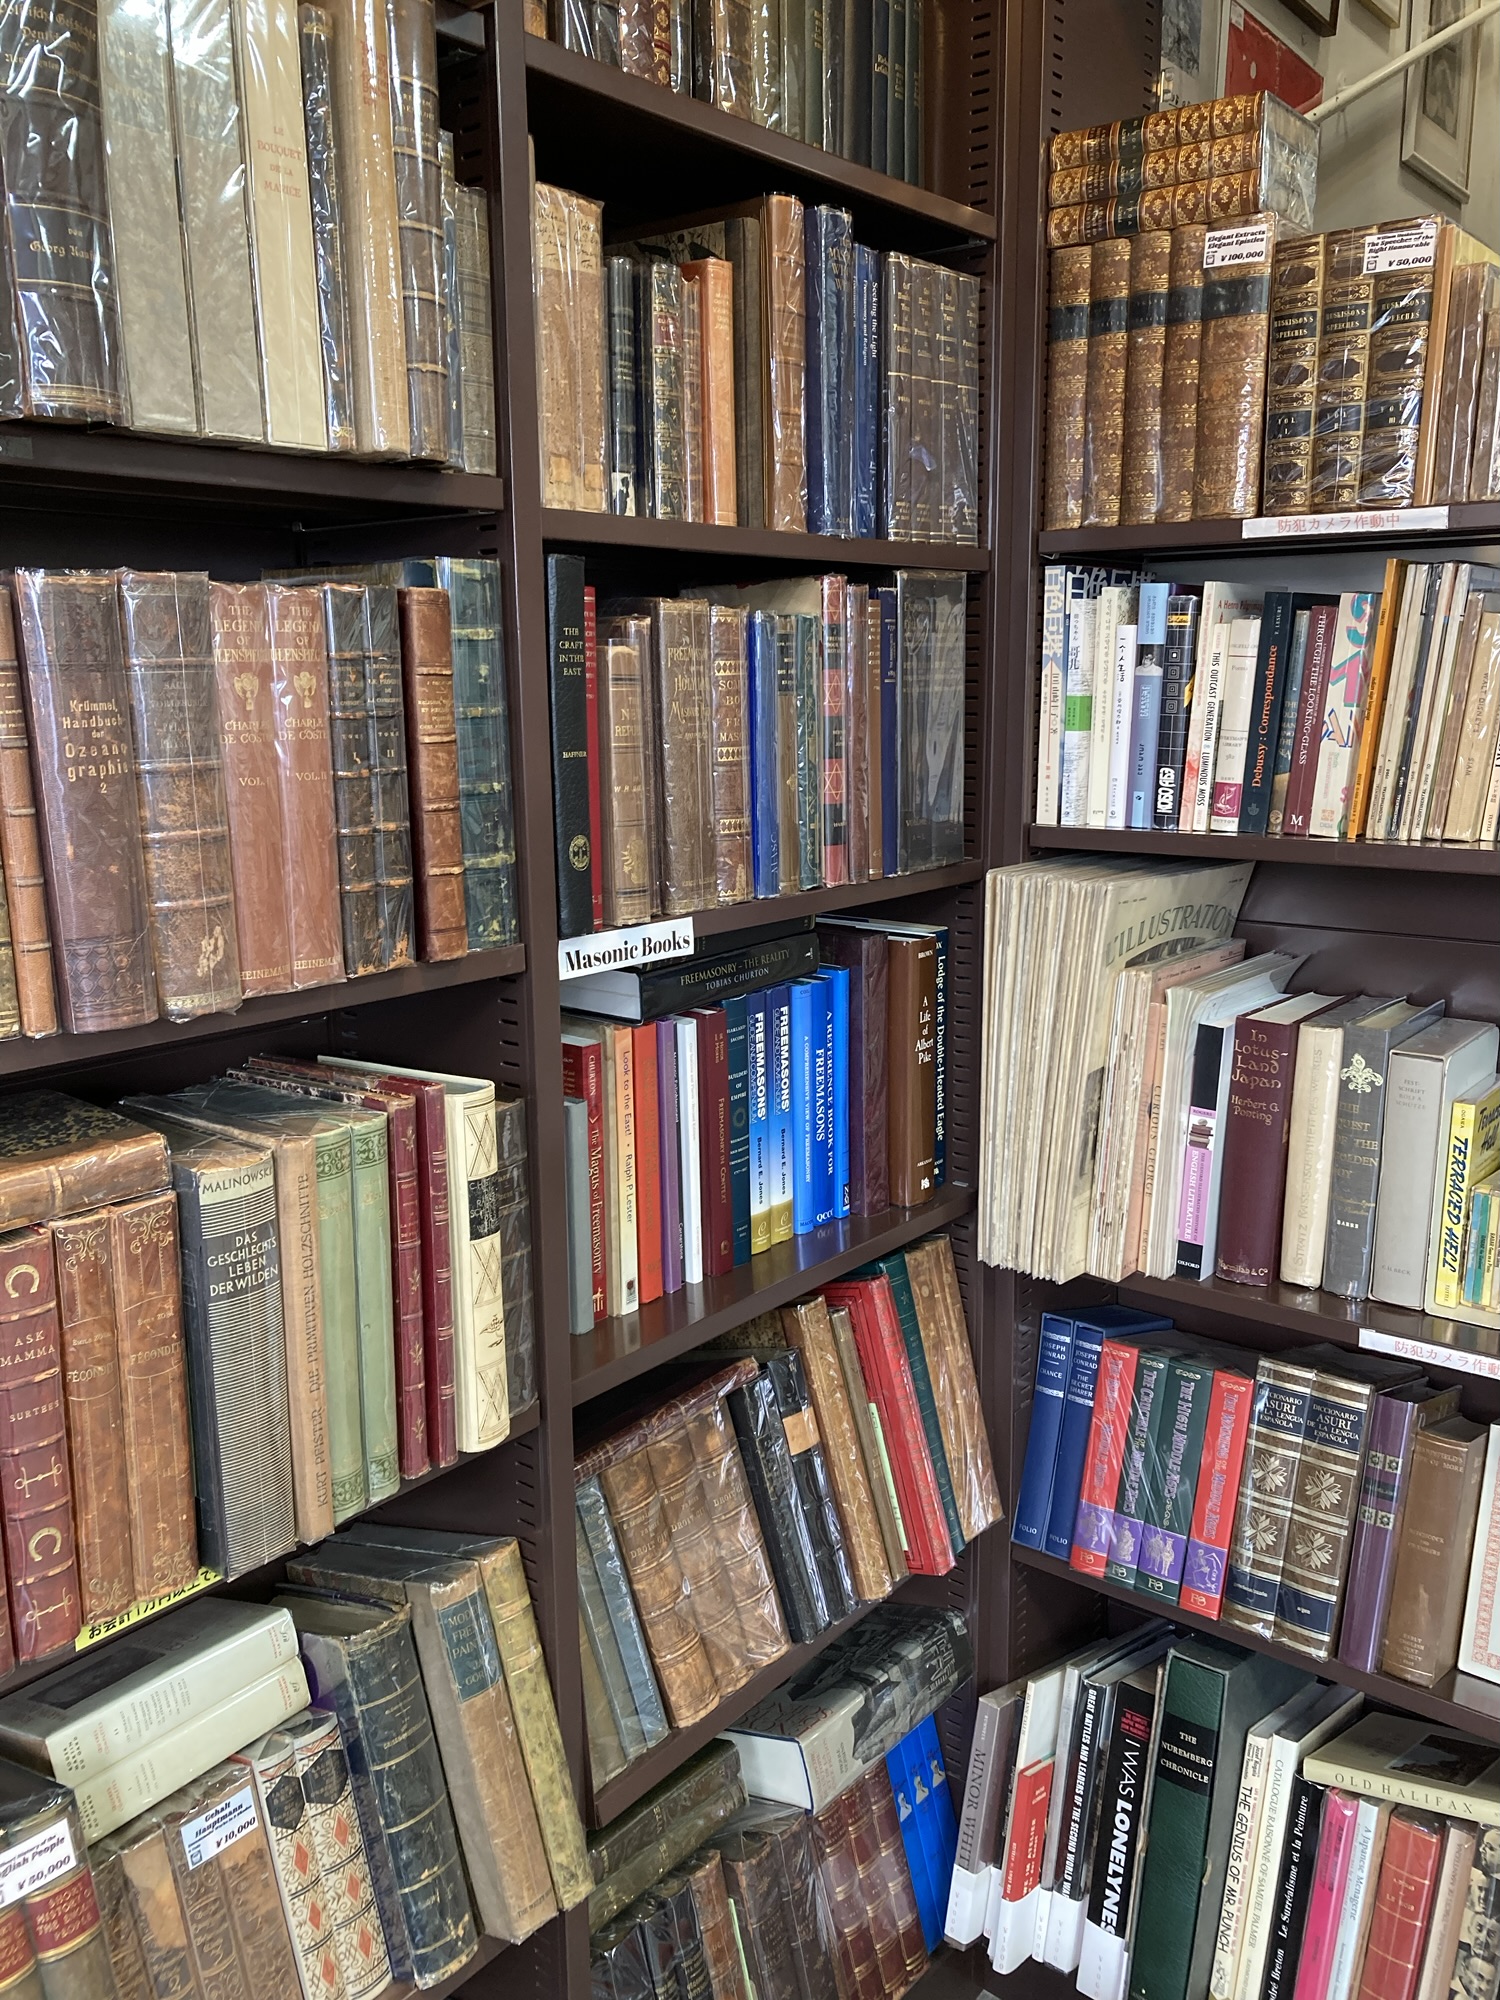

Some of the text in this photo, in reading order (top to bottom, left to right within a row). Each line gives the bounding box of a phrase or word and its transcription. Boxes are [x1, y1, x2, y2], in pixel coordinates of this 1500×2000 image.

[273, 126, 283, 136] LE
[258, 140, 302, 159] BOUQUET
[1208, 230, 1266, 243] Elegant Extracts
[1208, 237, 1265, 250] Elegant Epistles
[1367, 238, 1380, 247] The
[1381, 237, 1413, 247] Speeches
[1368, 241, 1430, 254] Right Honourable
[870, 282, 878, 317] Seeking
[1277, 512, 1400, 533] 防犯カメラ作動中
[228, 605, 250, 616] THE
[289, 606, 312, 617] THE
[237, 636, 250, 645] OF
[296, 636, 309, 645] OF
[563, 628, 579, 636] THE
[1312, 613, 1326, 664] THROUGH
[559, 641, 583, 650] CRAFT
[563, 668, 581, 676] EAST
[1310, 665, 1320, 686] THE
[70, 699, 118, 713] Krümmel,
[1251, 645, 1277, 787] Debussy Correspondance
[62, 714, 122, 729] Handbuch
[1197, 651, 1219, 806] THIS OUTCAST GENERATION LUMINOUS MOSS
[1299, 688, 1317, 765] LOOKING-GLASS
[91, 730, 104, 738] der
[279, 731, 295, 740] DE
[68, 759, 128, 782] graphie
[100, 782, 107, 794] 2
[1291, 814, 1304, 826] M
[565, 930, 691, 973] Masonic Books
[680, 947, 790, 986] FREEMASONRY THE REALITY
[705, 967, 769, 990] TOBIAS CHURTON
[919, 1009, 931, 1024] Life
[915, 1038, 934, 1052] Albert
[1251, 1030, 1267, 1042] In
[918, 1052, 931, 1064] Pike
[935, 955, 946, 1141] Lodge the Double-Headed Eagle
[622, 1050, 631, 1077] Look
[755, 1012, 767, 1120] FREEMASONS'
[779, 1005, 790, 1113] FREEMASONS'
[826, 1023, 834, 1106] REFERENCE
[1237, 1055, 1279, 1073] Land
[1232, 1068, 1281, 1089] Japan
[623, 1092, 631, 1111] the
[815, 1048, 825, 1142] FREEMASONS
[1231, 1095, 1267, 1110] Herbert
[1233, 1106, 1272, 1126] Ponting
[1145, 1085, 1162, 1198] CURIOUS GEORGE
[1354, 1138, 1379, 1150] THE
[625, 1153, 633, 1183] Ralph
[202, 1166, 272, 1195] MALINOWSKI
[1184, 1150, 1199, 1239] ENGLISH LITERATURE
[1442, 1135, 1469, 1273] TERRACED HELL
[589, 1146, 603, 1274] Magus Freemasonry
[236, 1231, 257, 1247] DAS
[1292, 1223, 1308, 1266] STRATZ
[207, 1237, 277, 1267] GESCHLECHTS
[229, 1255, 266, 1278] LEBEN
[210, 1264, 278, 1297] DER WILDEN
[15, 1330, 45, 1347] ASK
[297, 1174, 327, 1507] KURT PFISTER PRIMITIVEN HOLZSCHNITTE
[1043, 1341, 1066, 1351] JOSEPH
[0, 1344, 56, 1368] MAMMA
[1073, 1358, 1098, 1369] CONRAD
[1075, 1349, 1097, 1361] JOSEPH
[1039, 1368, 1063, 1379] CHANCE
[1076, 1373, 1089, 1382] THE
[1070, 1385, 1093, 1398] SHARER
[1071, 1379, 1094, 1391] SECRET
[9, 1400, 60, 1423] SURTEES
[1135, 1387, 1154, 1438] CRUCIBLE
[1263, 1397, 1297, 1415] ASURI
[1312, 1403, 1358, 1421] DICCIONARIO
[1260, 1414, 1293, 1429] ESPAÑOLA
[1276, 1411, 1304, 1424] LENGUA
[1316, 1413, 1351, 1431] ASURI
[1163, 1380, 1195, 1499] THE HIGH MIDDLE AGES
[1314, 1429, 1349, 1445] ESPAÑOLA
[1331, 1427, 1359, 1440] LENGUA
[1206, 1470, 1225, 1513] MIDDLE
[1019, 1523, 1037, 1535] FOLIO
[1049, 1533, 1068, 1545] FOLIO
[1179, 1732, 1197, 1745] THE
[1161, 1740, 1213, 1767] NUREMBERG
[966, 1747, 986, 1810] MINOR
[1118, 1751, 1140, 1799] WAS
[1160, 1758, 1209, 1783] CHRONICLE
[1063, 1689, 1097, 1880] GREAT BATTLES AND LEADERS THE SECOND WORLD
[1334, 1771, 1474, 1814] OLD HALIFAX
[195, 1803, 243, 1838] Hauptmann
[204, 1801, 231, 1822] Gehalt
[31, 1836, 65, 1860] People
[1247, 1759, 1284, 1949] CATALOGUE RAISONNÉ SAMUEL PALMER
[1217, 1786, 1253, 1953] THE GENIUS OF PUNCH
[1349, 1835, 1372, 1921] Japanese Menagerie
[1269, 1795, 1309, 1980] Breton Surréalisme Peinture
[36, 1921, 60, 1935] THE
